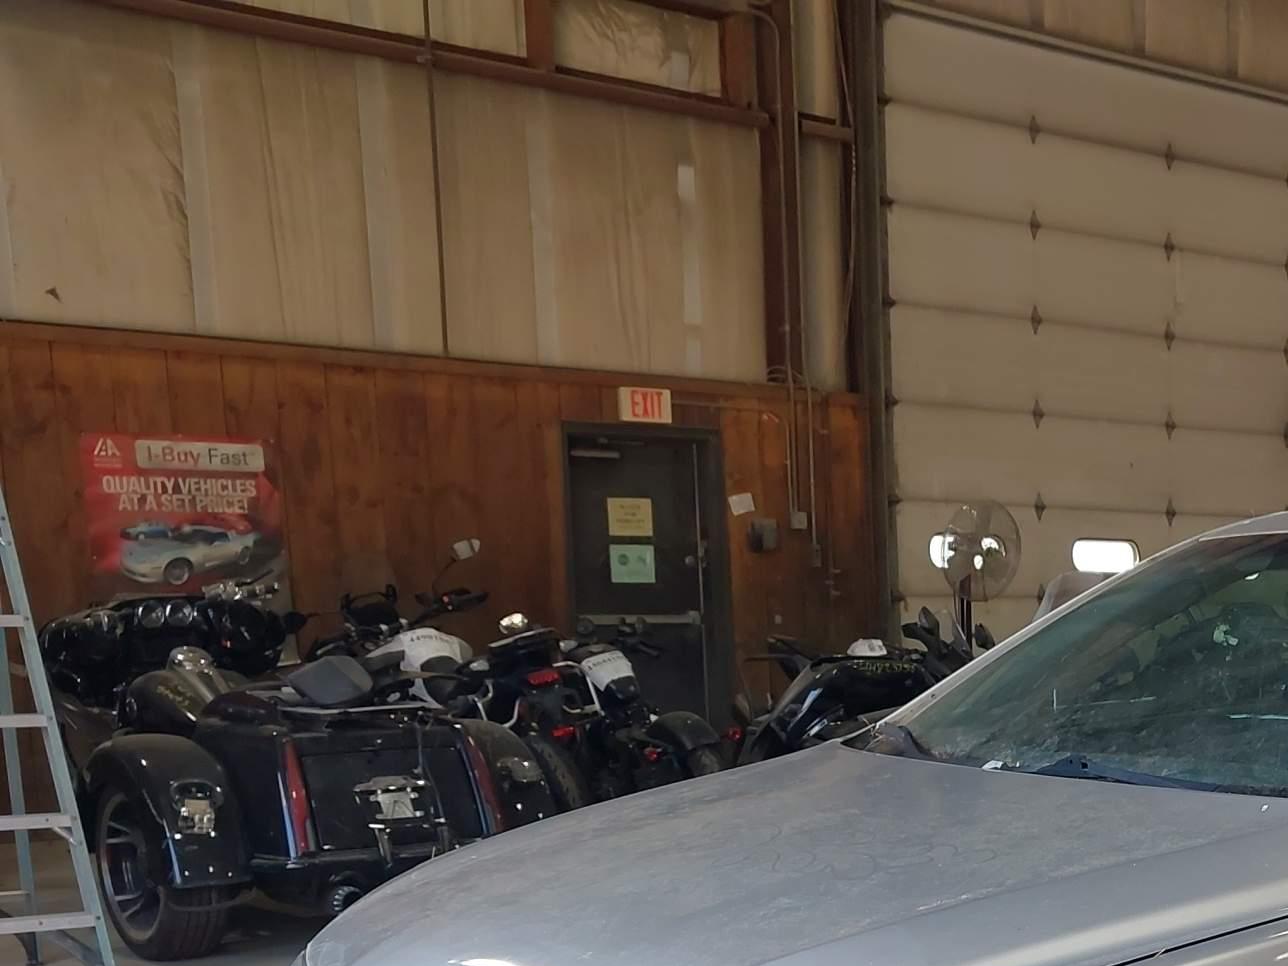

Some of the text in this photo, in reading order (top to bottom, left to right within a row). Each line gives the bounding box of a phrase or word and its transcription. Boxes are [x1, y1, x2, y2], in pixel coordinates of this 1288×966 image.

[631, 390, 663, 418] EXIT
[146, 445, 201, 466] I-Buy
[102, 475, 257, 497] QUALITY VEHICLES
[118, 494, 248, 514] AT A SET PRICE!
